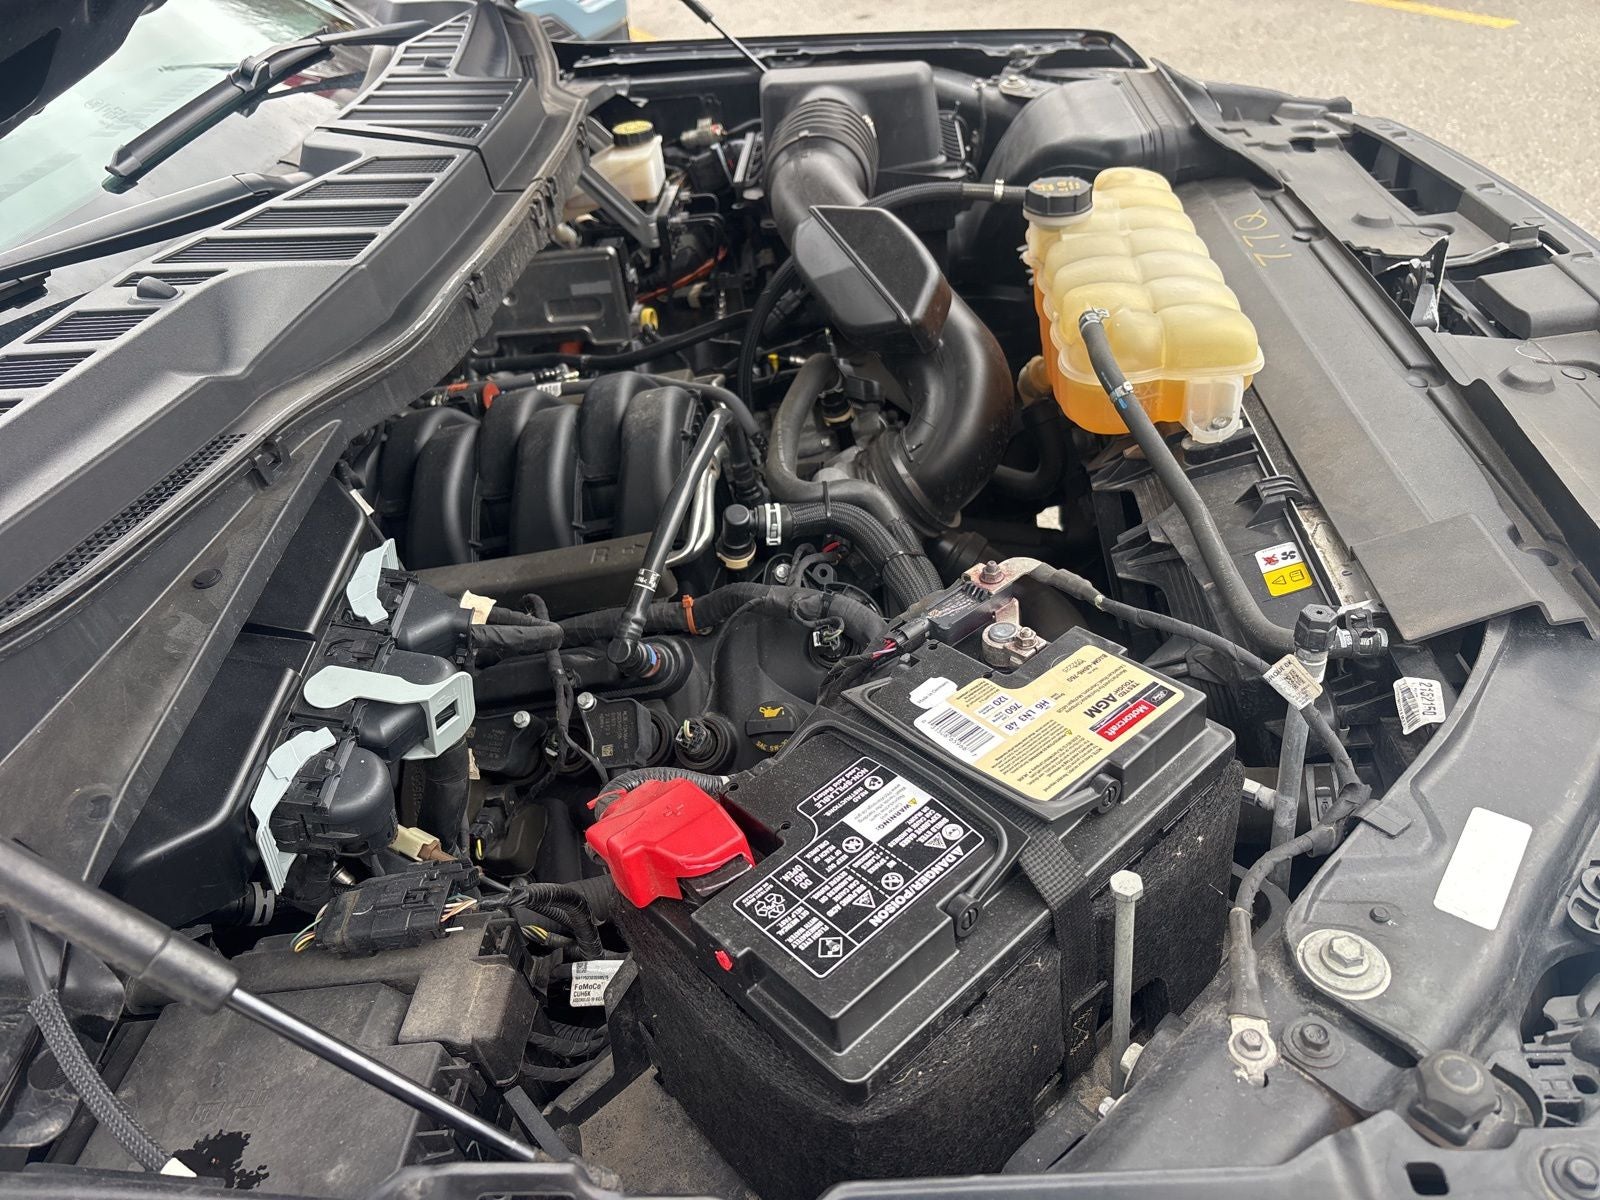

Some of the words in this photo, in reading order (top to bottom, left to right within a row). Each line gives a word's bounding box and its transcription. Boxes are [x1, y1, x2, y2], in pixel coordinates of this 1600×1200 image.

[1117, 681, 1140, 697] TESTED
[990, 695, 1009, 706] 120
[1033, 699, 1050, 710] H6
[1081, 692, 1120, 718] AGM
[1003, 702, 1023, 714] 760
[1016, 709, 1036, 722] LN3
[1102, 704, 1149, 736] Motorcraft
[1003, 720, 1019, 731] 48
[845, 767, 860, 779] Lead
[814, 768, 869, 809] NON-SPILLABLE
[833, 777, 846, 788] Acid
[812, 786, 834, 802] Battery
[852, 790, 868, 802] READ
[824, 787, 864, 816] INSTRUCTIONS.
[919, 804, 929, 812] OR
[874, 803, 911, 831] WARNING:
[922, 808, 935, 818] CAN
[909, 816, 926, 829] CAUSE
[912, 810, 942, 835] EXPLOSIVE
[886, 826, 913, 848] BLINDNESS
[897, 832, 917, 848] GASES
[818, 843, 837, 858] REACH
[831, 848, 842, 857] OF
[811, 855, 822, 864] OF
[823, 854, 835, 864] THE
[833, 852, 849, 865] KEEP
[850, 848, 874, 868] SMOKING
[859, 852, 880, 870] FLAMES
[865, 856, 887, 874] SPARKS
[885, 859, 897, 868] NO
[778, 863, 802, 882] OPEN.
[823, 862, 837, 873] OUT
[788, 870, 807, 886] NOT
[798, 877, 813, 890] DO
[826, 869, 847, 887] SEVERE
[846, 878, 860, 889] CAN
[825, 874, 853, 897] BLINDNESS
[867, 852, 957, 927] DANGER/POISON
[817, 894, 828, 904] OR
[831, 886, 850, 902] CAUSE
[838, 883, 867, 906] SULFURIC
[788, 904, 804, 918] HELP
[796, 908, 810, 919] GET
[824, 903, 842, 917] ACID
[775, 915, 792, 929] FAST.
[775, 916, 800, 937] MEDICAL
[801, 915, 819, 929] WITH
[788, 919, 824, 949] IMMEDIATELY
[809, 923, 829, 940] FLUSH
[797, 936, 813, 951] EYES
